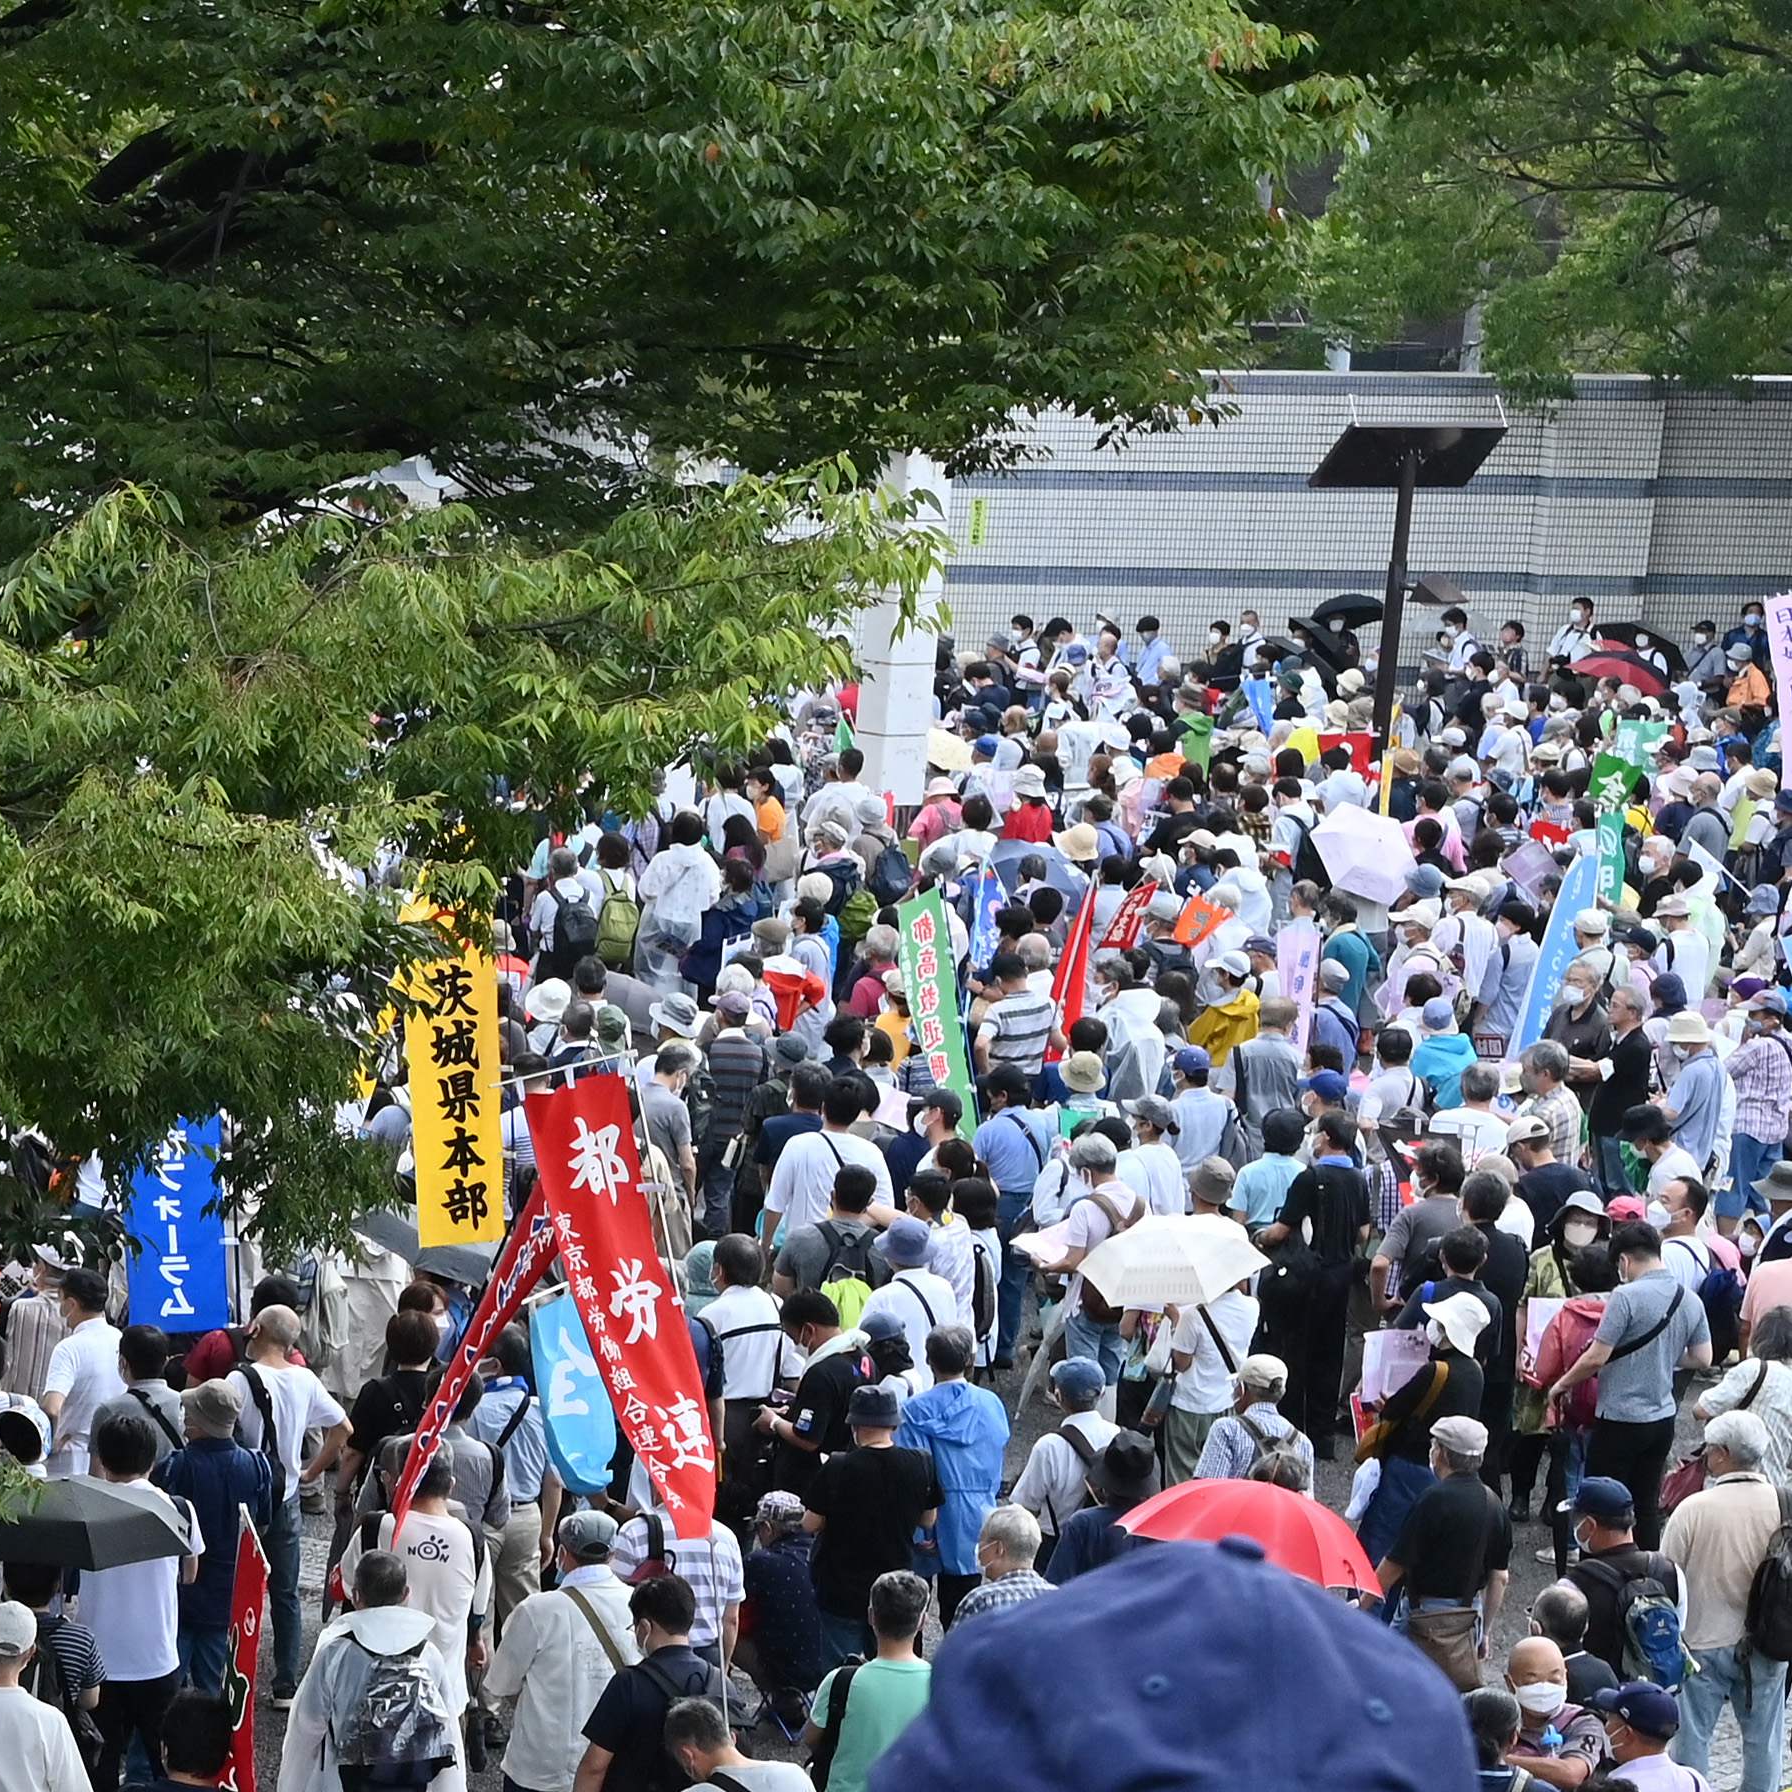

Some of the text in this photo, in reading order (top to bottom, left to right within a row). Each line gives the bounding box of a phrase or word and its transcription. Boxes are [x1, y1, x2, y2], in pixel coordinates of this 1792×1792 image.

[431, 964, 490, 1232] 茨城県本部
[567, 1115, 716, 1474] 都労連
